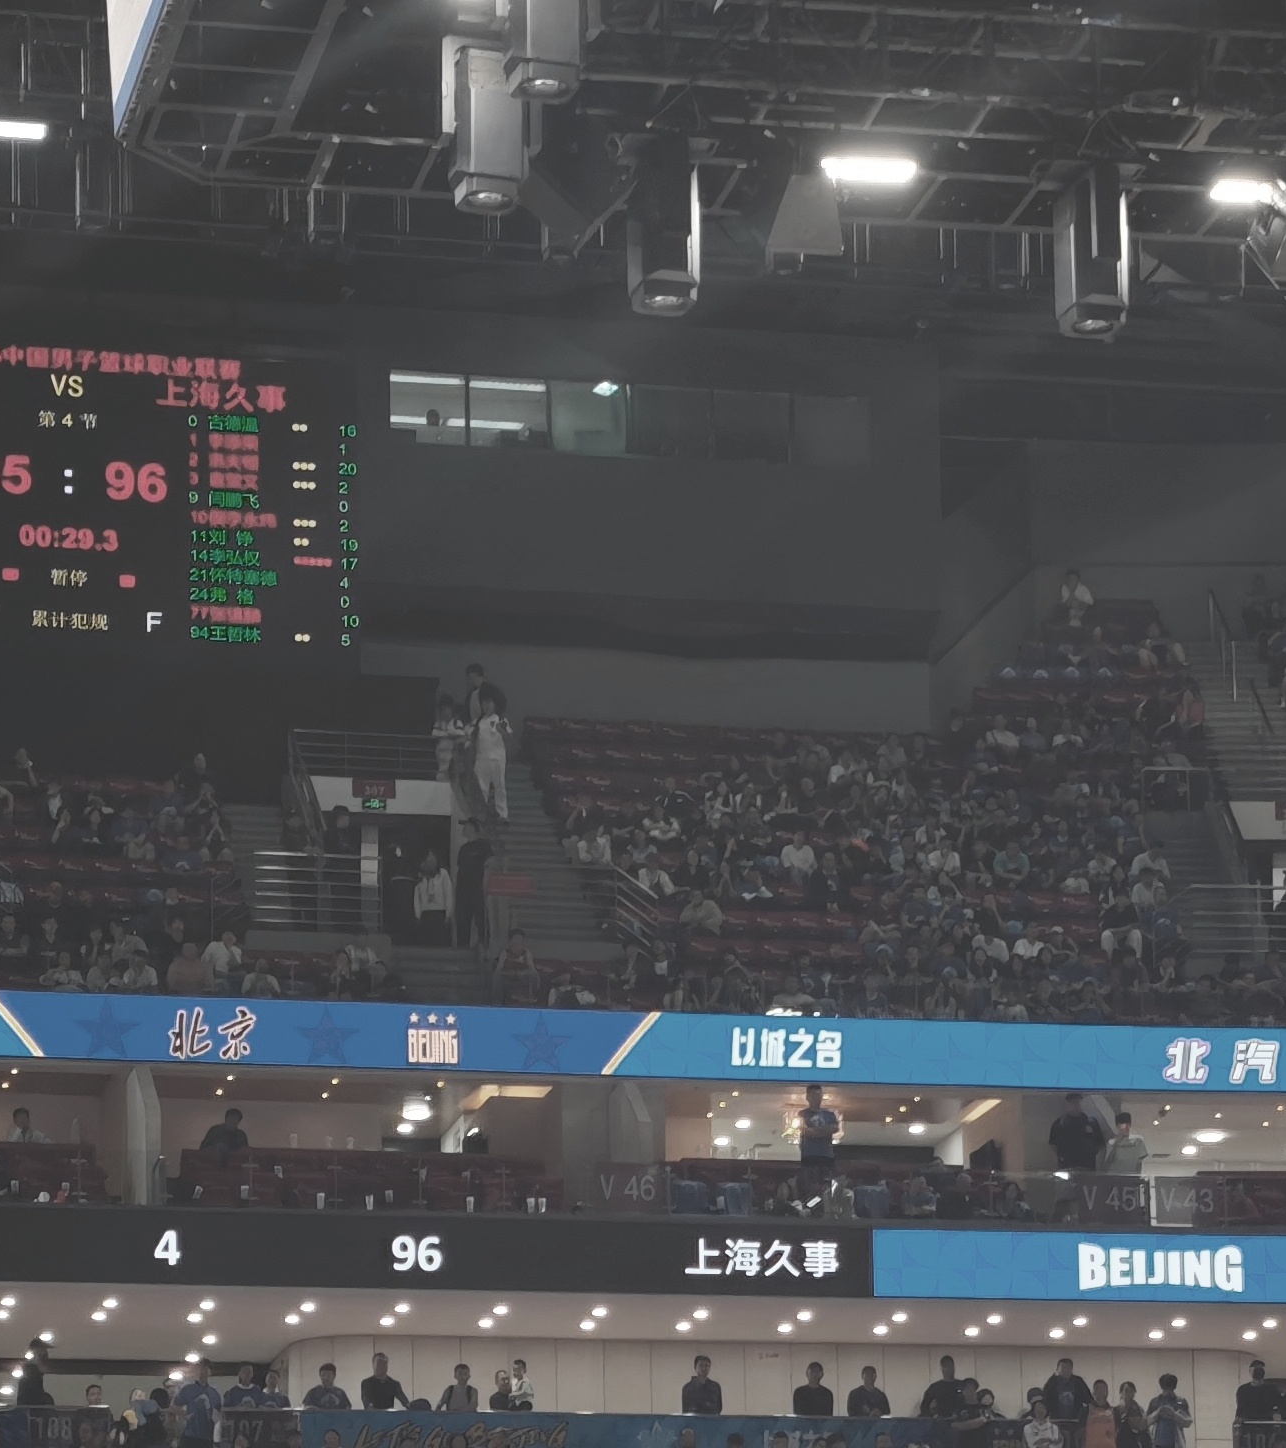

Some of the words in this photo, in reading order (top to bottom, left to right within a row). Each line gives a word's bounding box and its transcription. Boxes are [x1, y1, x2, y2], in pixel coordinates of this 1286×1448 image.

[50, 373, 84, 397] VS
[188, 415, 198, 428] 0
[339, 444, 346, 456] 1
[339, 463, 357, 476] 20
[105, 461, 168, 503] 96
[339, 482, 349, 495] 2
[339, 501, 348, 513] 0
[19, 524, 119, 551] 00:29.3
[190, 530, 206, 542] 11
[339, 520, 349, 533] 2
[191, 550, 207, 562] 14
[340, 558, 358, 571] 17
[189, 569, 206, 581] 21
[340, 577, 349, 589] 4
[189, 588, 207, 601] 24
[340, 596, 350, 609] 0
[146, 611, 163, 633] F
[341, 616, 359, 628] 10
[168, 1007, 257, 1062] 北京
[730, 1028, 843, 1070] 以城之名
[600, 1174, 617, 1202] V
[625, 1175, 656, 1203] 46
[1084, 1186, 1099, 1211] V
[1104, 1185, 1137, 1212] 45
[154, 1230, 181, 1266] 4
[392, 1235, 443, 1273] 96
[685, 1238, 840, 1279] 上海久事
[1078, 1242, 1244, 1294] BEIJING
